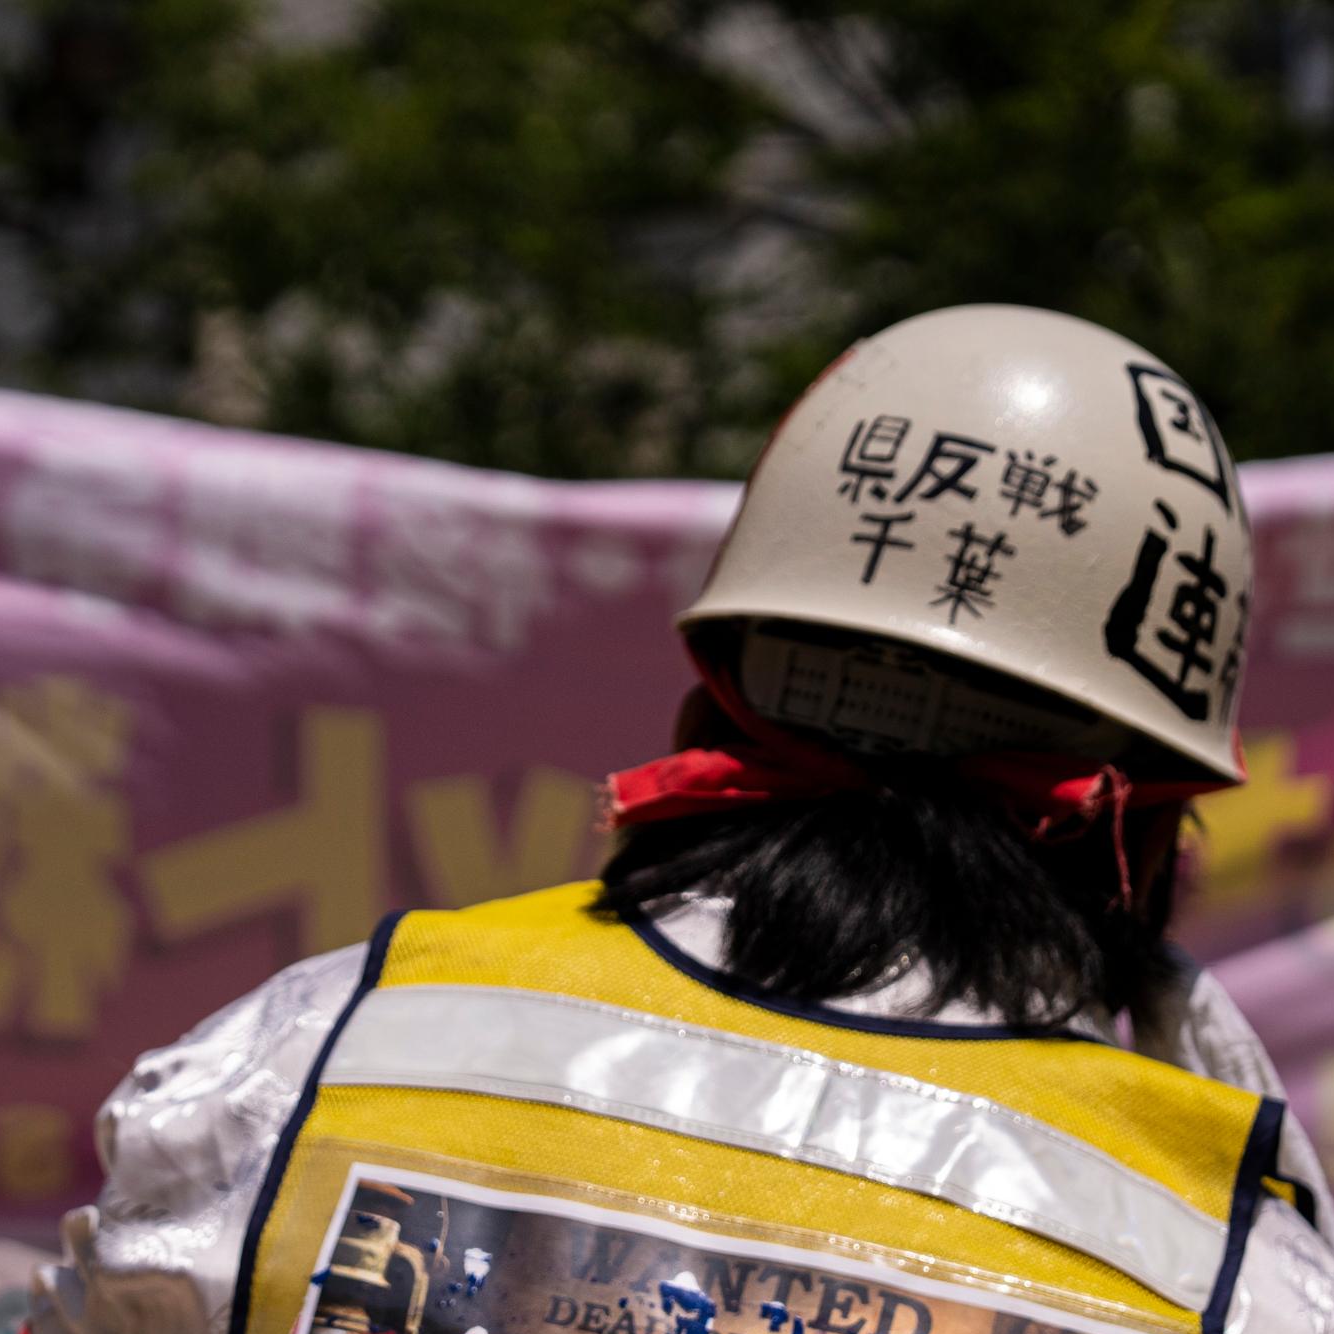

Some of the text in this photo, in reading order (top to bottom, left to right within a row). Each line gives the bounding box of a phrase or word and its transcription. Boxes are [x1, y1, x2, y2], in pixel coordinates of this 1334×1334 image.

[836, 414, 1100, 537] 県反戦
[850, 511, 1018, 626] 千葉
